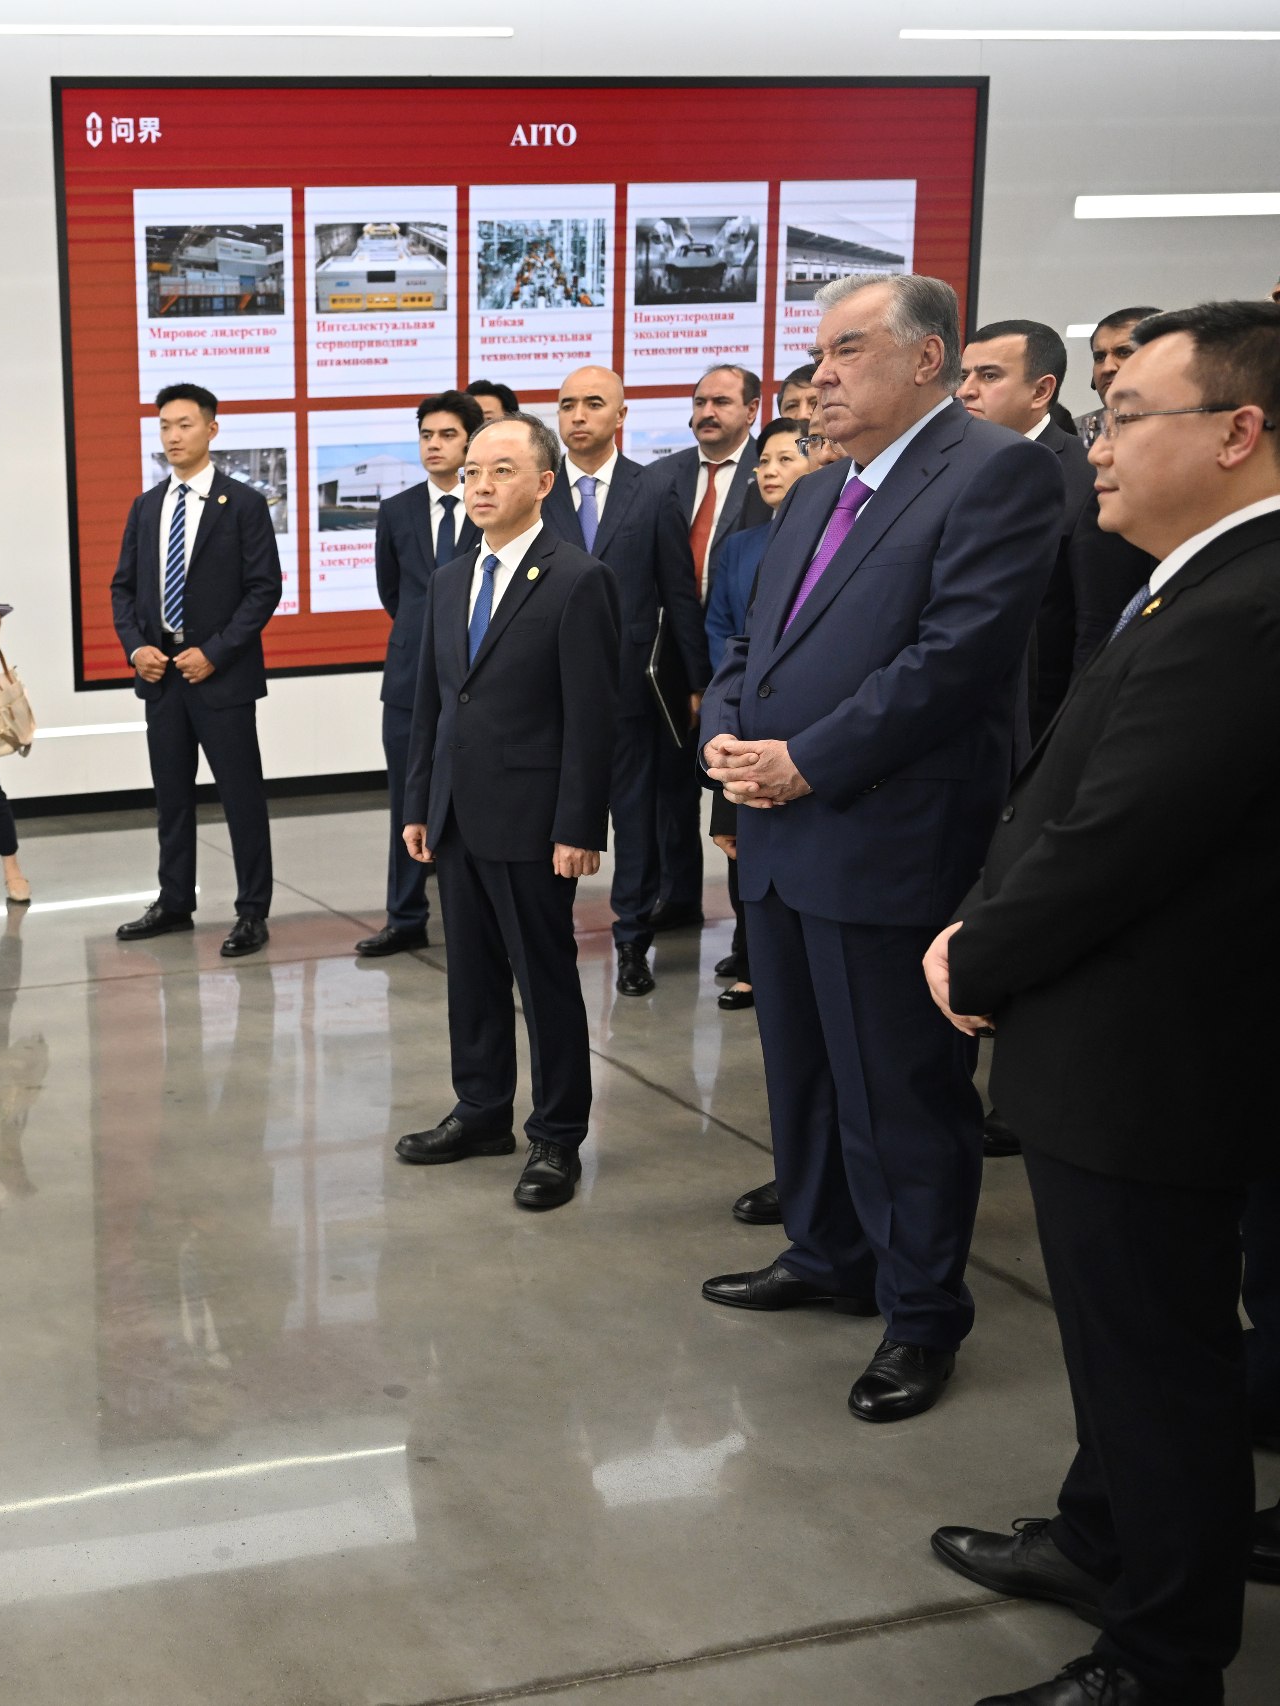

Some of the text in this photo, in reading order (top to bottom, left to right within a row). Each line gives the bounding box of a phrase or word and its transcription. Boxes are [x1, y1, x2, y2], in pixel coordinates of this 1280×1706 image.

[111, 116, 162, 144] 问界
[509, 123, 578, 147] AITO
[634, 311, 735, 324] Низкоуглеродная
[784, 306, 823, 318] Интел
[316, 320, 435, 334] Интеллектуальная
[481, 315, 525, 328] Гибкая
[149, 326, 277, 341] Мировое лидерство
[634, 329, 708, 340] экологичная
[783, 325, 819, 335] логис
[316, 338, 418, 352] сервоприводная
[480, 333, 593, 346] интеллектуальная
[149, 345, 271, 358] в литье алюминия
[481, 351, 591, 362] технология кузова
[634, 344, 750, 357] технология окраски
[320, 541, 373, 553] Технолог
